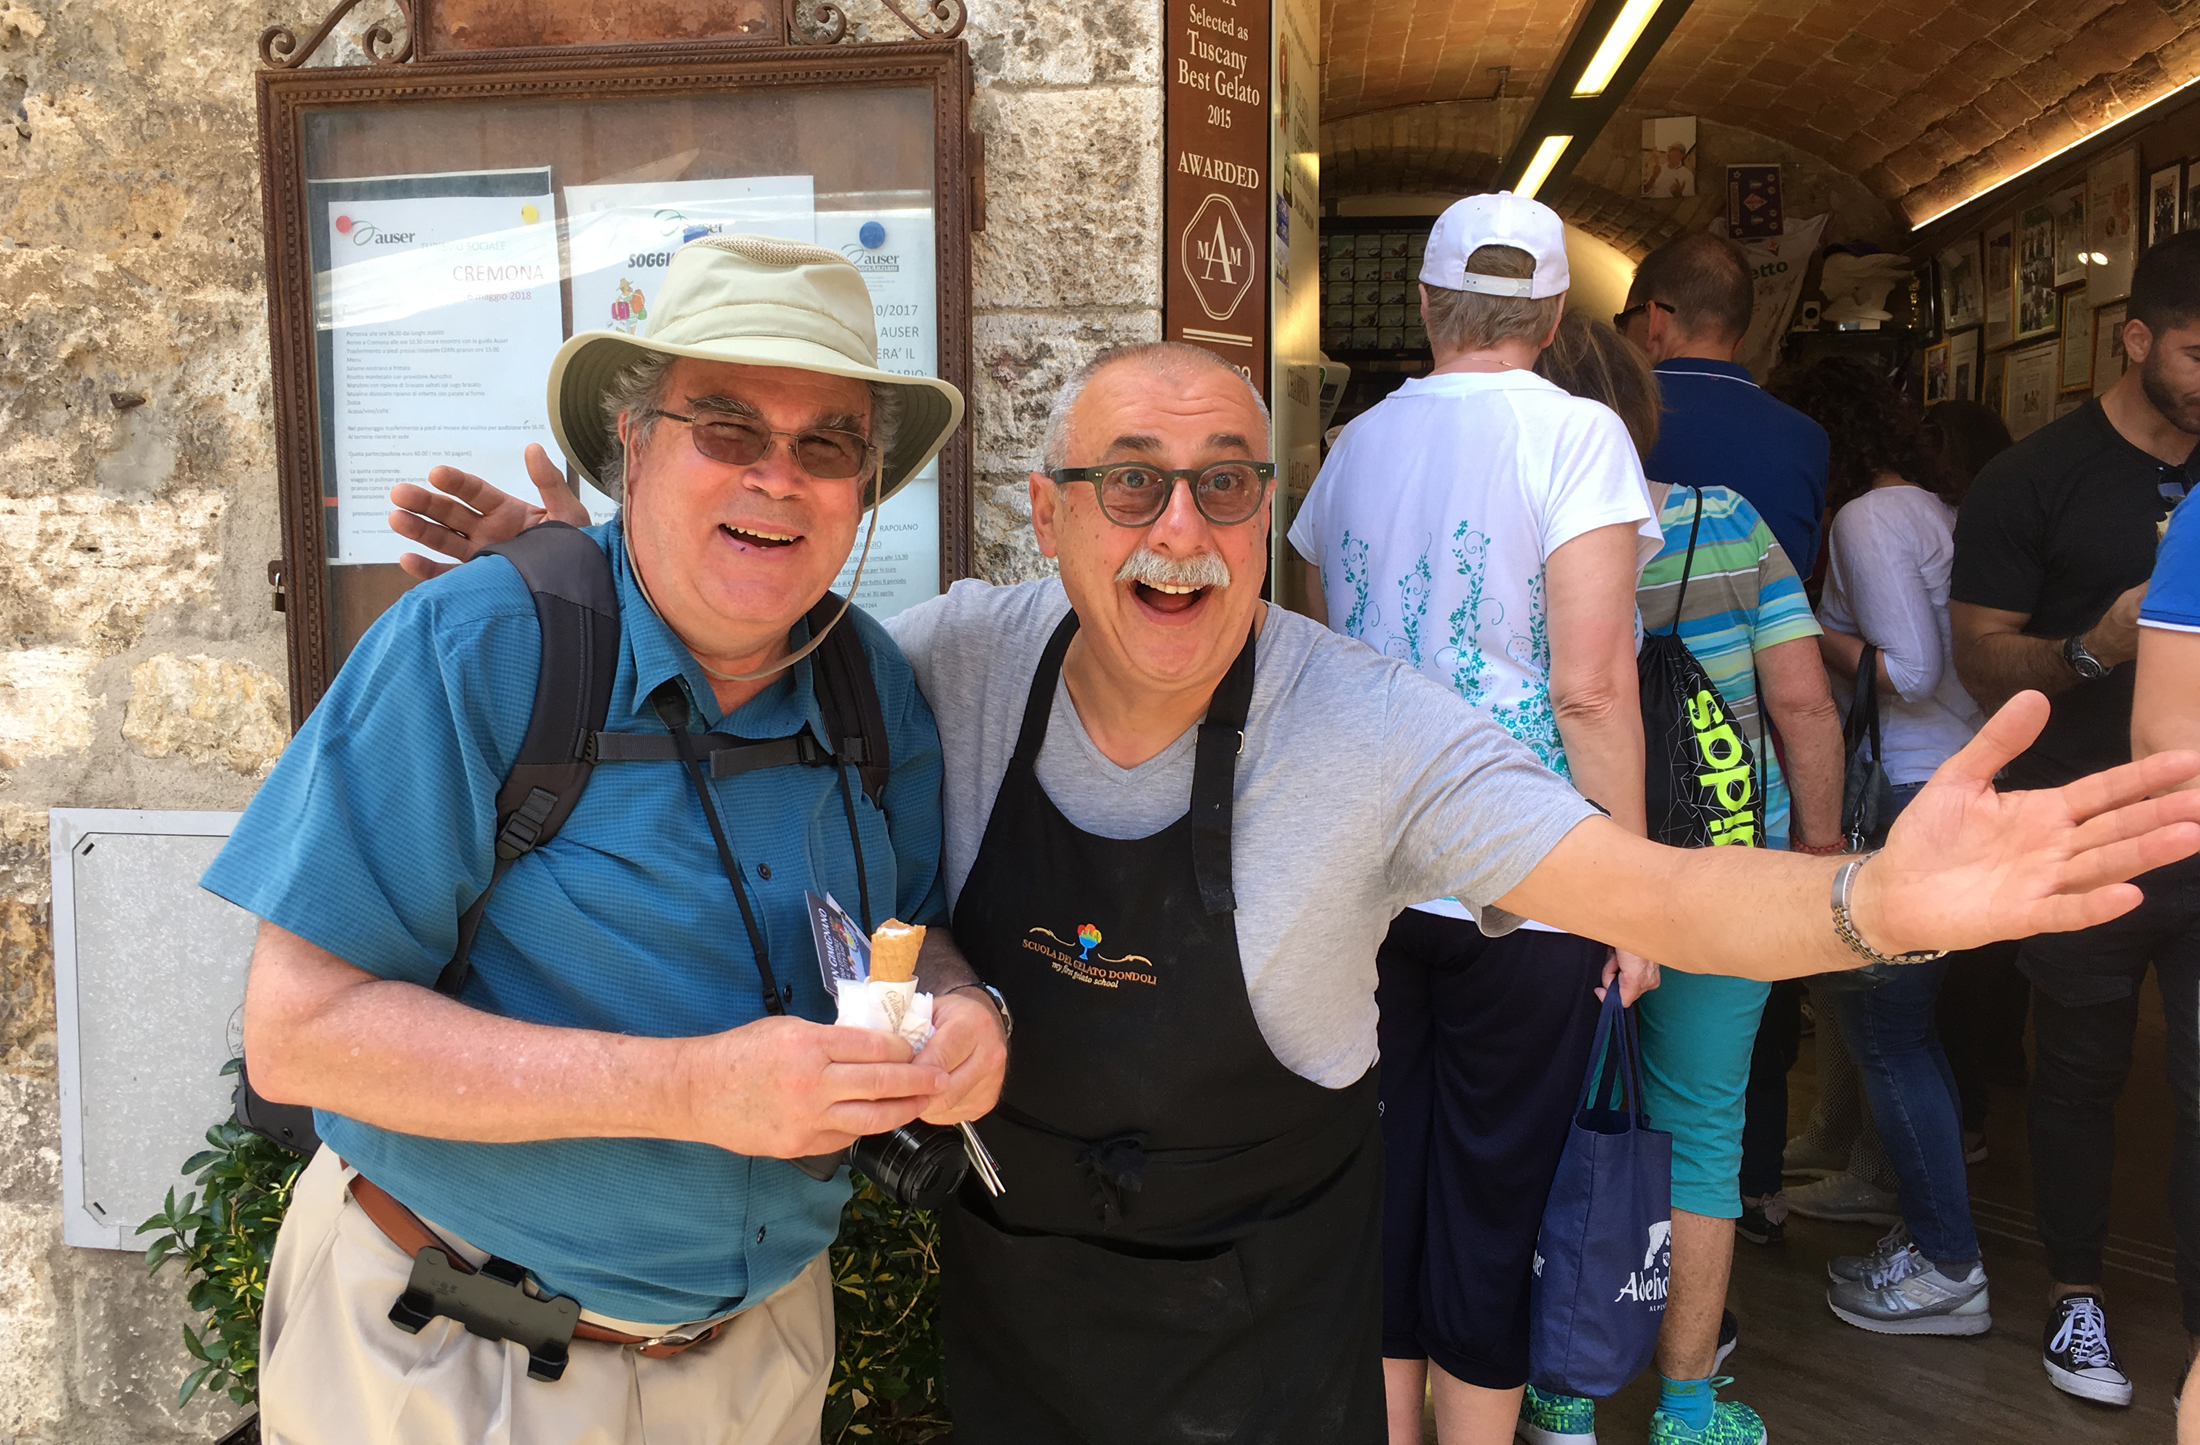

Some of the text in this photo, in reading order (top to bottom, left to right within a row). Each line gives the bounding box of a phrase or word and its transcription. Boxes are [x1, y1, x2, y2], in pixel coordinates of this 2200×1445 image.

[1189, 3, 1248, 42] Selected as
[1187, 27, 1248, 79] Tuscany
[1177, 58, 1210, 92] Best
[1214, 70, 1260, 106] Gelato
[1207, 104, 1231, 129] 2015
[1177, 150, 1260, 190] AWARDED
[374, 231, 416, 245] auser
[466, 241, 506, 251] SOCIALE
[628, 252, 677, 269] SOGGI
[864, 255, 900, 265] auser
[453, 265, 544, 282] CREMONA
[467, 292, 532, 302] 6 maggio 2018
[880, 326, 919, 338] AUSER
[906, 348, 915, 359] IL
[879, 523, 919, 532] RAPOLANO
[818, 907, 838, 967] GIMIGNANO
[1022, 939, 1157, 985] SCUOLA DEL GELATO DONDOLI
[1051, 962, 1062, 972] my
[1093, 978, 1119, 988] school
